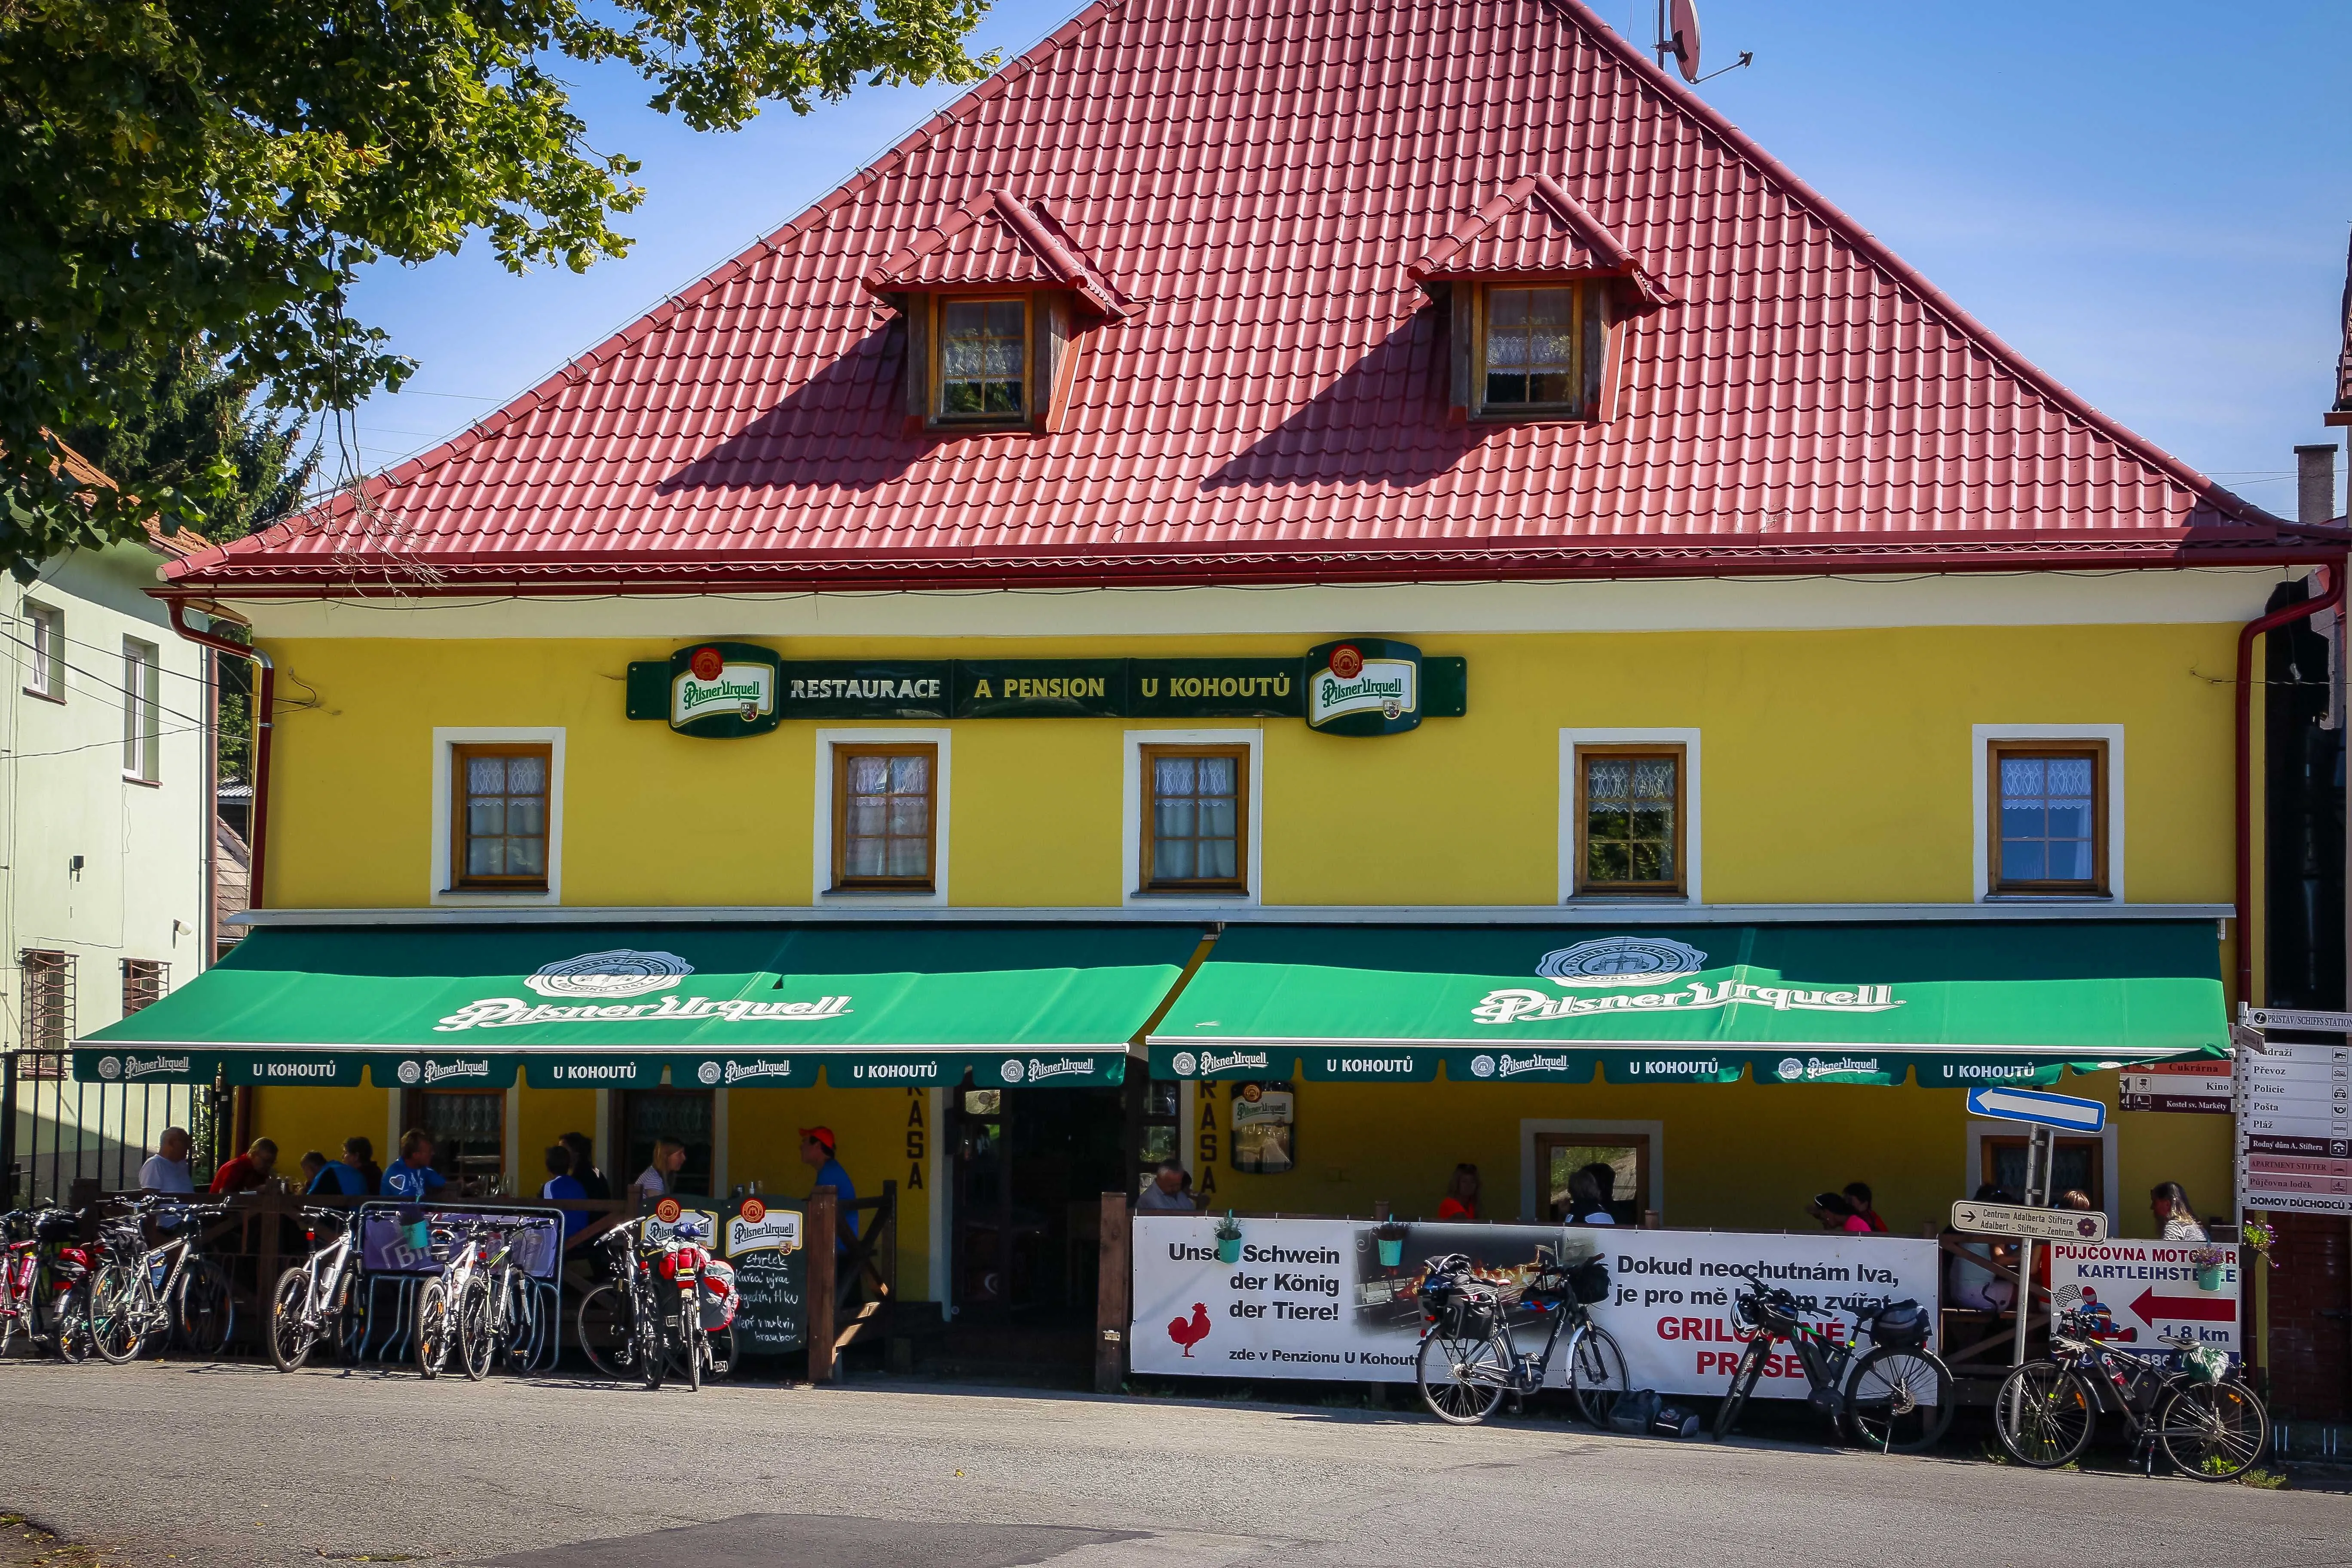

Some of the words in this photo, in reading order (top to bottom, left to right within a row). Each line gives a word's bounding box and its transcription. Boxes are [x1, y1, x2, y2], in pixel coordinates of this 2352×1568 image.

[790, 680, 940, 698] RESTAURACE
[974, 680, 992, 697] A
[1004, 678, 1104, 698] PENSION
[1142, 679, 1158, 697] U
[1170, 672, 1290, 697] KOHOUTŮ
[1322, 678, 1363, 707] Pilsner
[1361, 676, 1402, 699] Urquell
[683, 680, 722, 710] Pilsner
[720, 679, 760, 702] Urquell
[1471, 989, 1694, 1024] Pilsner
[1687, 980, 1897, 1012] Urquell
[432, 998, 658, 1031] Pilsner
[655, 995, 852, 1022] Urquell
[2254, 1048, 2293, 1057] ádraží
[125, 1056, 158, 1079] Pilsner
[157, 1056, 189, 1072] Urquell
[253, 1064, 262, 1076] U
[268, 1060, 336, 1076] KOHOUTŮ
[425, 1060, 458, 1083] Pilsner
[456, 1060, 488, 1076] Urquell
[554, 1066, 563, 1078] U
[568, 1062, 636, 1078] KOHOUTŮ
[725, 1060, 759, 1084] Pilsner
[758, 1060, 790, 1076] Urquell
[854, 1065, 863, 1078] U
[868, 1061, 937, 1078] KOHOUTŮ
[1028, 1059, 1062, 1082] Pilsner
[1061, 1057, 1093, 1074] Urquell
[1200, 1051, 1235, 1075] Pilsner
[1233, 1051, 1266, 1069] Urquell
[1327, 1060, 1336, 1072] U
[1342, 1055, 1412, 1072] KOHOUTŮ
[1499, 1054, 1534, 1078] Pilsner
[1534, 1054, 1567, 1071] Urquell
[1630, 1062, 1639, 1074] U
[1645, 1057, 1718, 1075] KOHOUTŮ
[1807, 1058, 1845, 1079] Pilsner
[1843, 1057, 1877, 1073] Urquell
[1943, 1065, 1954, 1077] U
[1959, 1062, 2034, 1077] KOHOUTŮ
[2169, 1063, 2218, 1072] Cukrárna
[2254, 1066, 2286, 1075] Převoz
[2206, 1082, 2229, 1090] Kino
[2254, 1084, 2285, 1093] Policie
[1237, 1102, 1262, 1120] Pilsner
[1262, 1102, 1287, 1115] Urquell
[2199, 1102, 2227, 1111] Markéty
[2254, 1102, 2279, 1112] Pošta
[2253, 1120, 2273, 1129] Pláž
[2253, 1140, 2273, 1149] Rodný
[2251, 1161, 2295, 1170] APARTMENT
[2250, 1178, 2288, 1187] Půjčovna
[2291, 1180, 2312, 1188] loděk
[2250, 1196, 2288, 1207] DOMOV
[2290, 1196, 2345, 1210] DŮCHODCŮ
[1983, 1208, 2010, 1220] Centrum
[2013, 1212, 2045, 1223] Adalberta
[2048, 1215, 2073, 1225] Stiftera
[734, 1222, 766, 1245] Pilsner
[764, 1222, 794, 1238] Urquell
[1981, 1220, 2009, 1231] Adalbert
[2017, 1224, 2039, 1234] Stifter
[2047, 1226, 2074, 1237] Zentrum
[1168, 1243, 1221, 1262] Unse
[1242, 1243, 1340, 1265] Schwein
[1617, 1255, 1693, 1277] Dokud
[1700, 1260, 1850, 1283] neochutnám
[1229, 1271, 1268, 1291] der
[1274, 1273, 1340, 1297] König
[1614, 1283, 1638, 1307] je
[1645, 1288, 1684, 1308] pro
[1690, 1286, 1728, 1306] mě
[1229, 1299, 1267, 1319] der
[1272, 1301, 1339, 1321] Tiere!
[2199, 1326, 2230, 1342] km
[1229, 1348, 1256, 1361] zde
[1259, 1352, 1268, 1361] v
[1272, 1349, 1340, 1364] Penzionu
[1344, 1351, 1356, 1364] U
[1360, 1352, 1418, 1366] Kohout
[1696, 1351, 1805, 1379] PRSE
